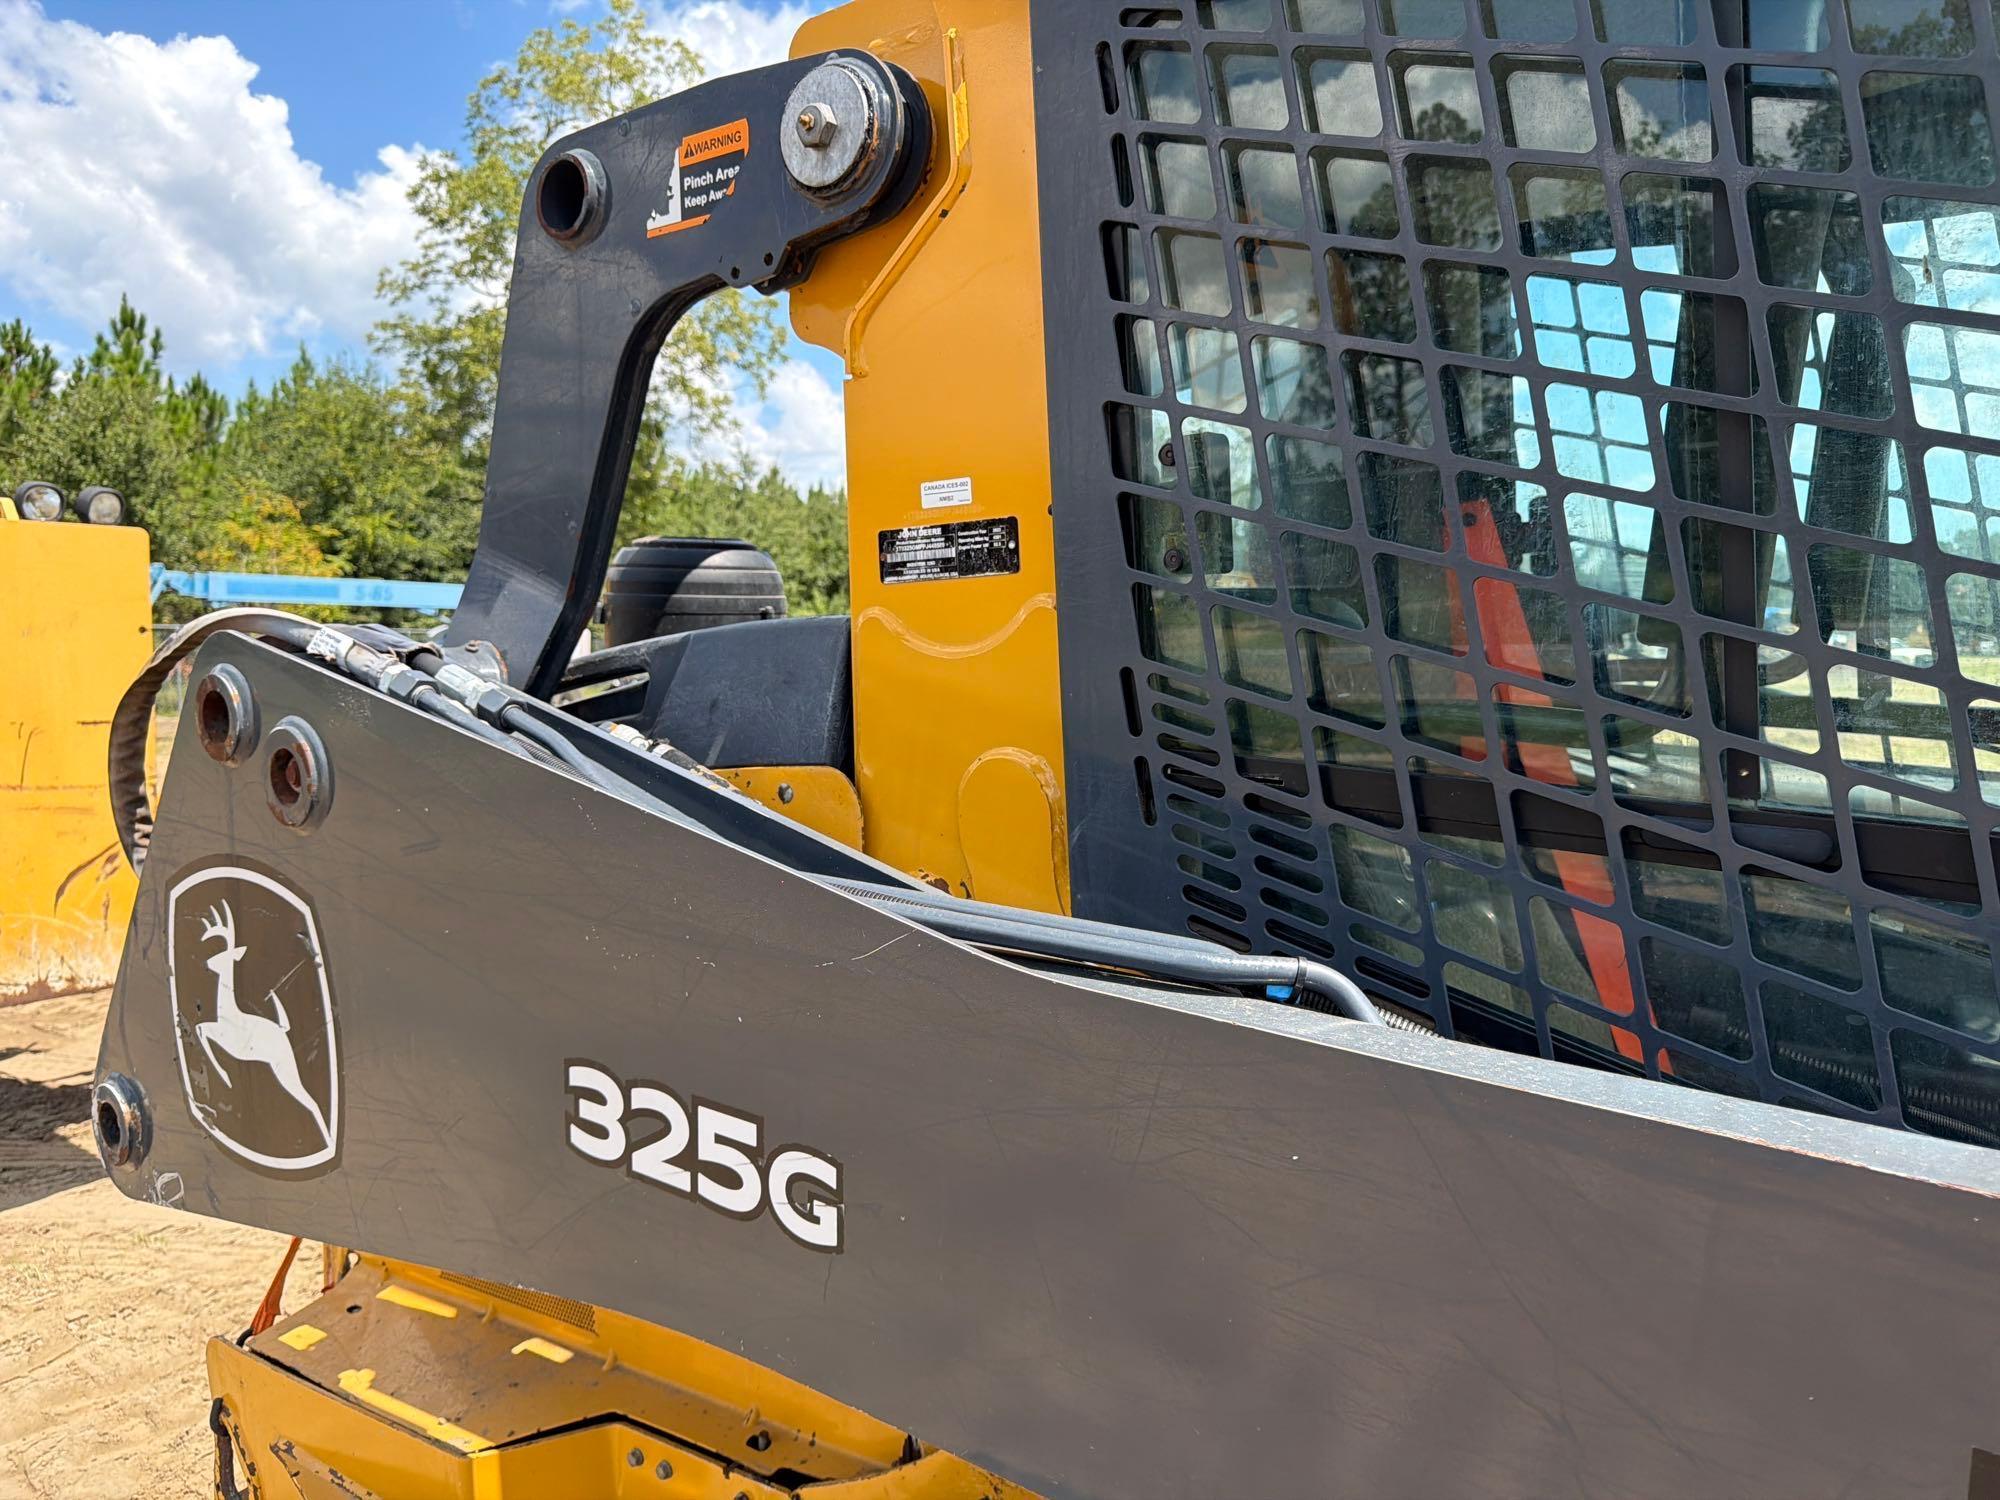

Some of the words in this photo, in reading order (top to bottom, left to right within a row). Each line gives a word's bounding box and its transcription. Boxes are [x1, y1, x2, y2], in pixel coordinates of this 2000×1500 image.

[694, 130, 742, 155] WARNING
[683, 171, 713, 191] Pinch
[684, 192, 708, 209] Keep
[923, 483, 945, 492] CANADA
[946, 480, 969, 489] ICES-002
[897, 528, 918, 540] JOHN
[918, 527, 942, 537] DEERE
[568, 1065, 838, 1248] 325G
